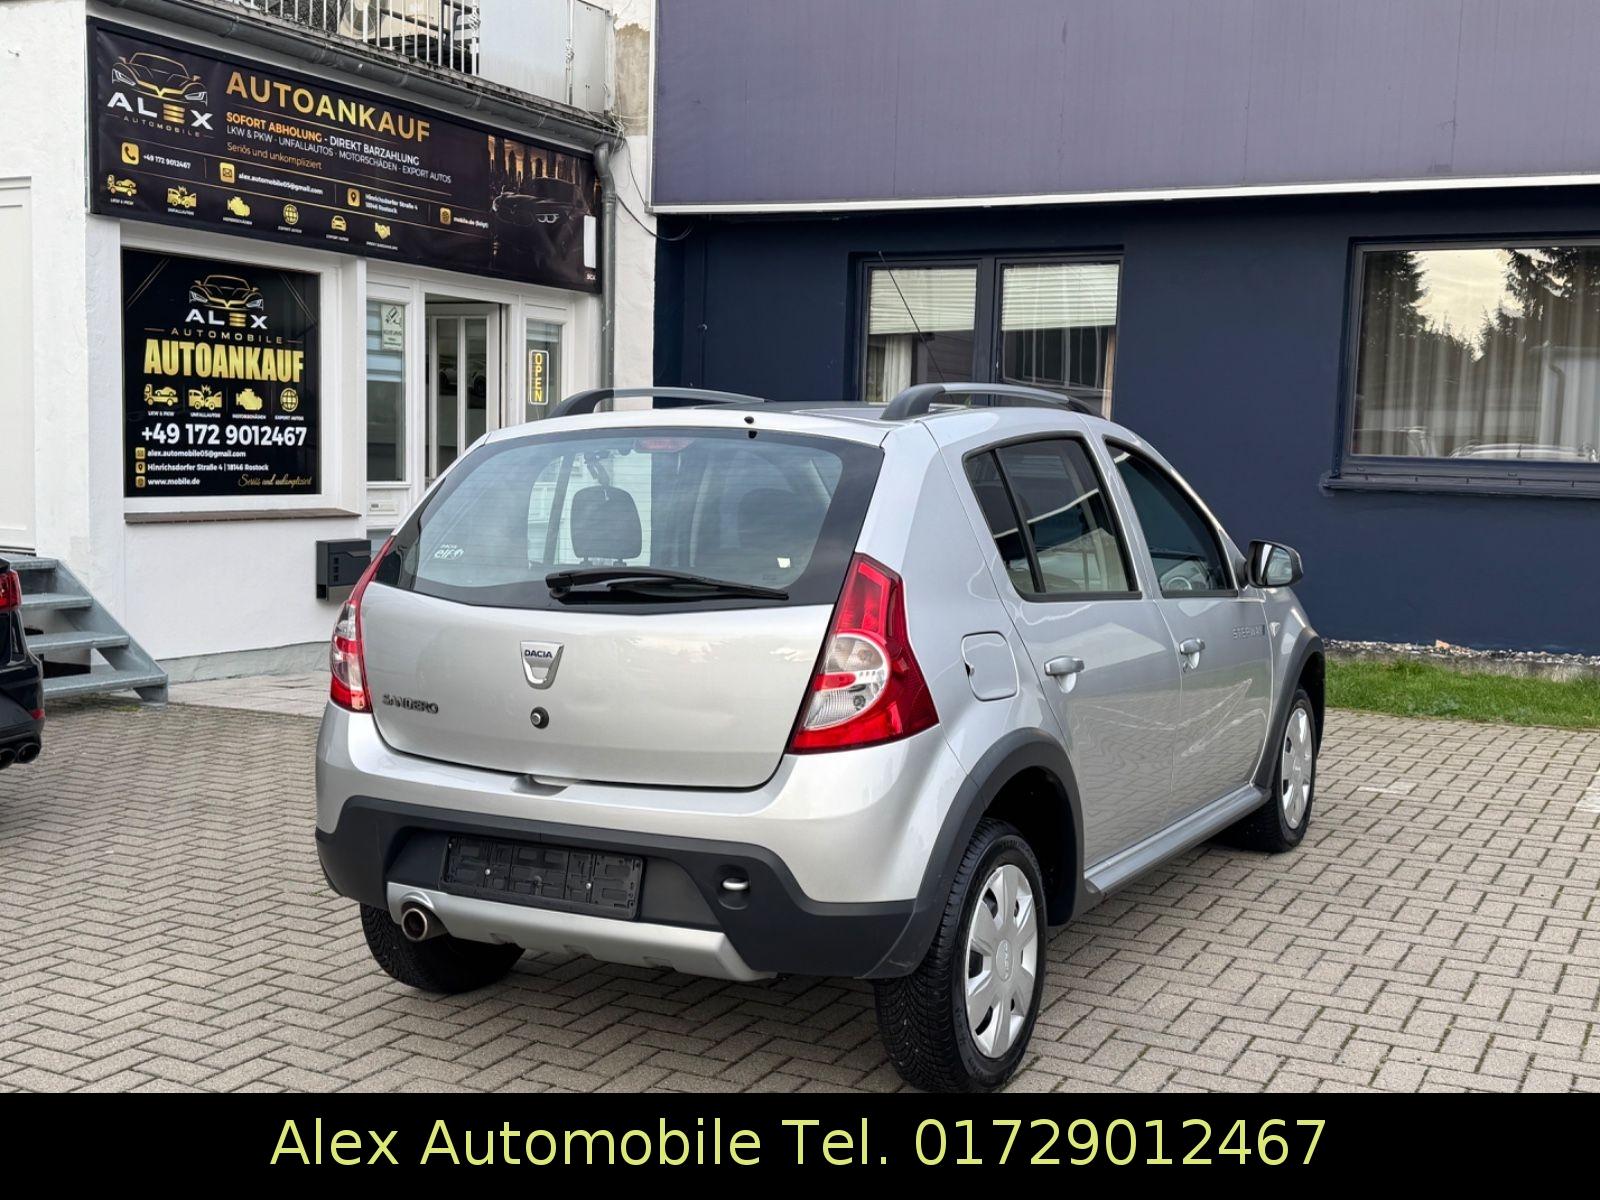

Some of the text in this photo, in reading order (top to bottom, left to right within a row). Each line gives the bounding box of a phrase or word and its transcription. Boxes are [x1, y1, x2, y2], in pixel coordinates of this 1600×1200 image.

[107, 91, 214, 131] ALEX
[226, 71, 430, 142] AUTOANKAUF
[123, 115, 201, 138] AUTOMOBILE
[226, 111, 266, 130] SOFORT
[268, 123, 322, 143] ABHOLUNG
[329, 135, 362, 152] DIREKT
[363, 143, 420, 166] BARZAHLUNG
[155, 156, 165, 165] 172
[226, 124, 245, 137] LKW
[246, 129, 252, 139] &
[253, 131, 273, 143] PKW
[278, 136, 334, 157] UNFALLAUTOS
[339, 150, 398, 172] MOTORSCHÄDEN
[402, 165, 429, 179] EXPORT
[429, 172, 452, 184] AUTOS
[252, 148, 268, 159] und
[269, 152, 322, 170] unkompliziert
[185, 309, 268, 330] ALEX
[171, 327, 283, 344] AUTOMOBILE
[143, 338, 304, 383] AUTOANKAUF
[533, 352, 543, 403] OPEN
[141, 422, 307, 446] +49 172 9012467
[147, 448, 246, 459] alex.automobile05@gmail.com
[244, 463, 269, 471] Rostock
[147, 477, 200, 485] www.mobile.de
[524, 649, 553, 658] DACIA
[382, 693, 439, 715] SANDERO
